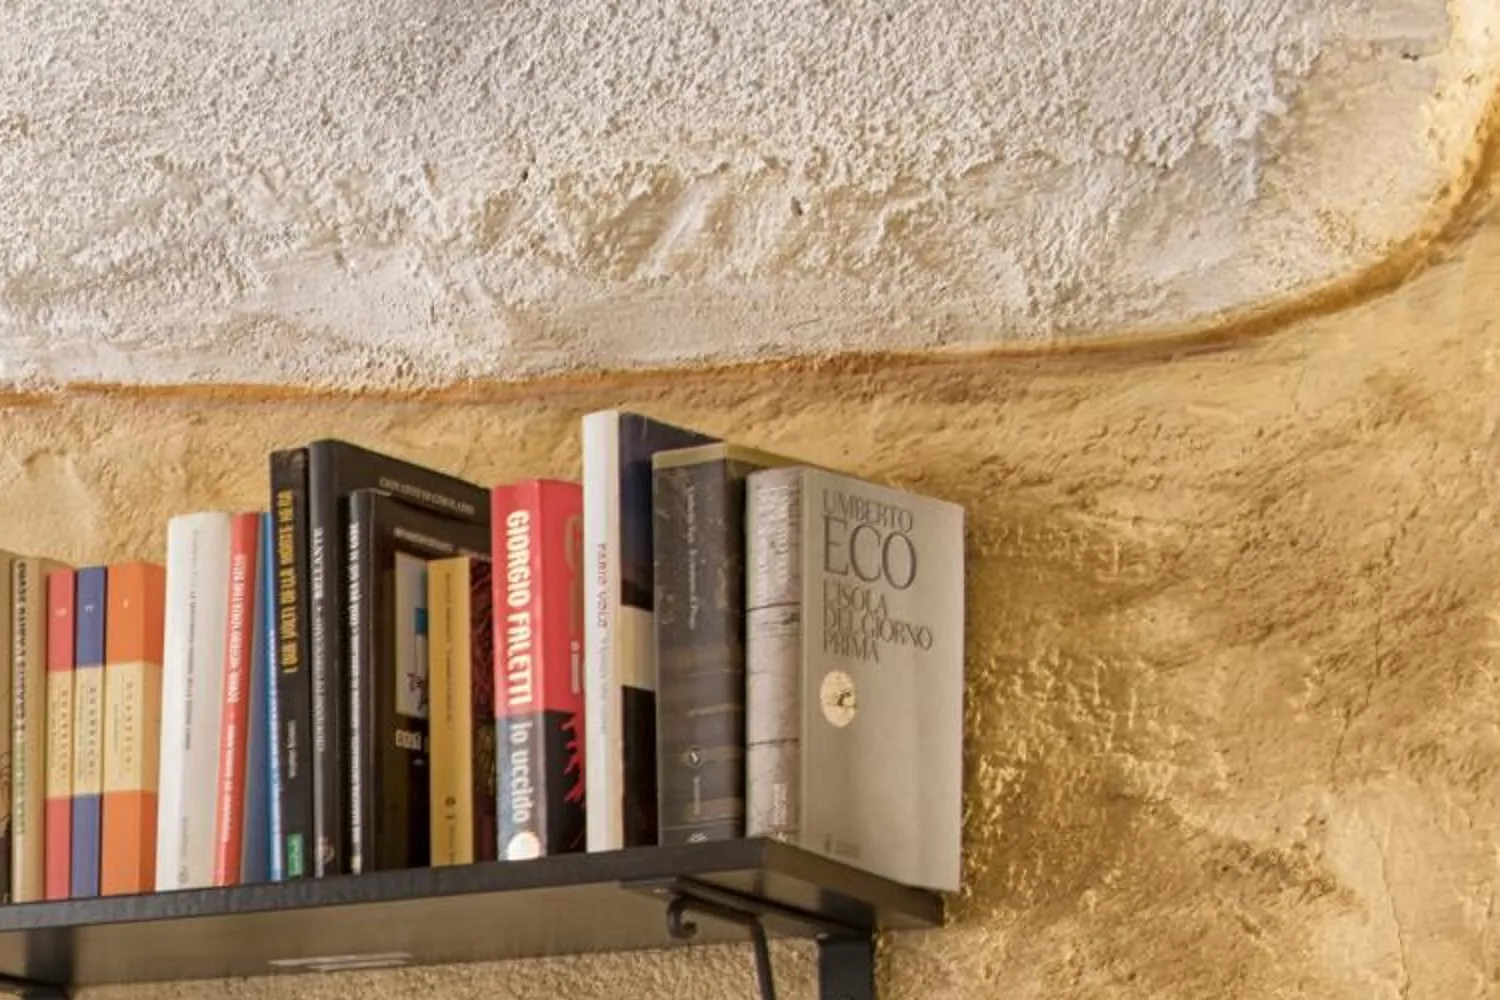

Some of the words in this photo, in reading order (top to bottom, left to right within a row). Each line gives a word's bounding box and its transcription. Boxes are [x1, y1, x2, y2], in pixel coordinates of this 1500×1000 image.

[822, 489, 914, 532] UMBERTO
[506, 511, 530, 607] GIORGIO
[822, 518, 917, 590] ECO
[508, 612, 532, 705] FALETTI
[823, 612, 861, 638] DEL
[862, 611, 933, 652] GIORNO
[511, 722, 530, 743] io
[511, 750, 533, 823] uccido
